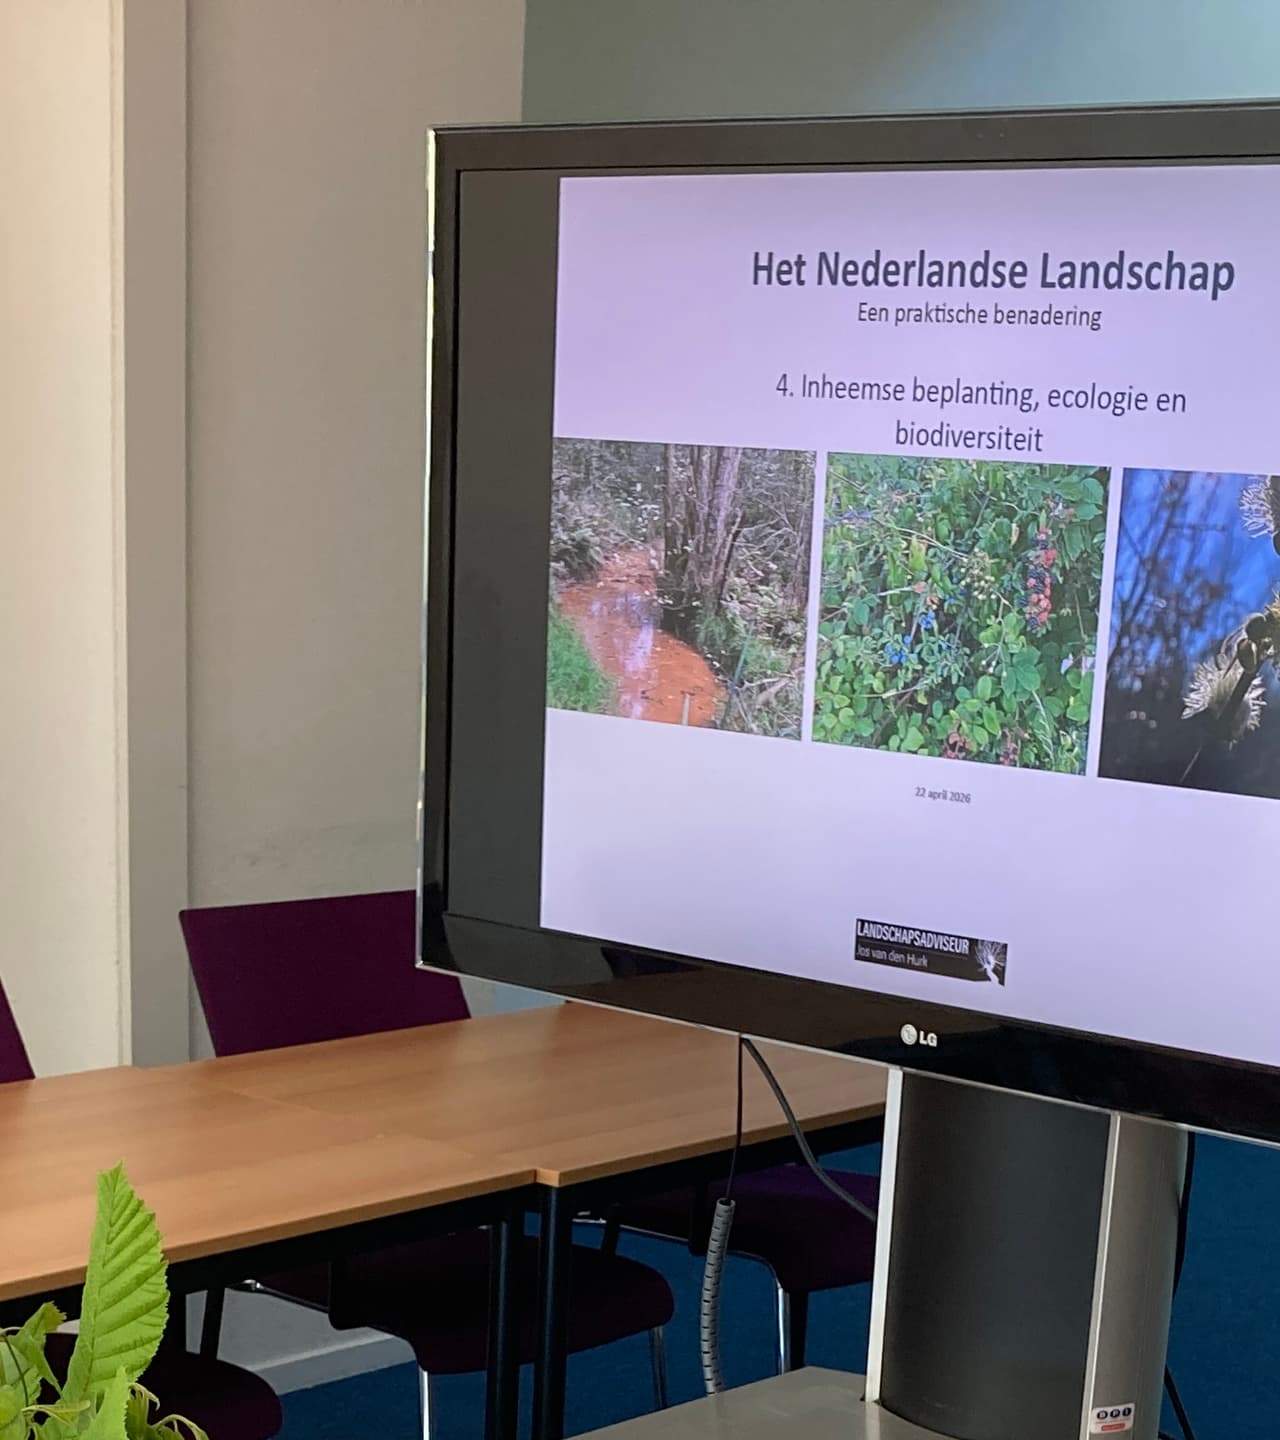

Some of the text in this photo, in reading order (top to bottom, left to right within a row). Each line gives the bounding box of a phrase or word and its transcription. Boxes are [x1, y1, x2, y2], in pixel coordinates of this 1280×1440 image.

[753, 250, 1235, 300] Het Nederlandse Landschap
[858, 302, 1102, 331] Een praktische benadering
[776, 373, 1187, 417] 4. Inheemse beplanting, ecologie en
[895, 420, 1044, 452] biodiversiteit
[915, 787, 926, 798] 22
[928, 789, 947, 800] april
[857, 920, 969, 954] LANDSCHAPSADVISEUR
[856, 944, 928, 968] Jos van den Hurk
[920, 1030, 937, 1047] LG
